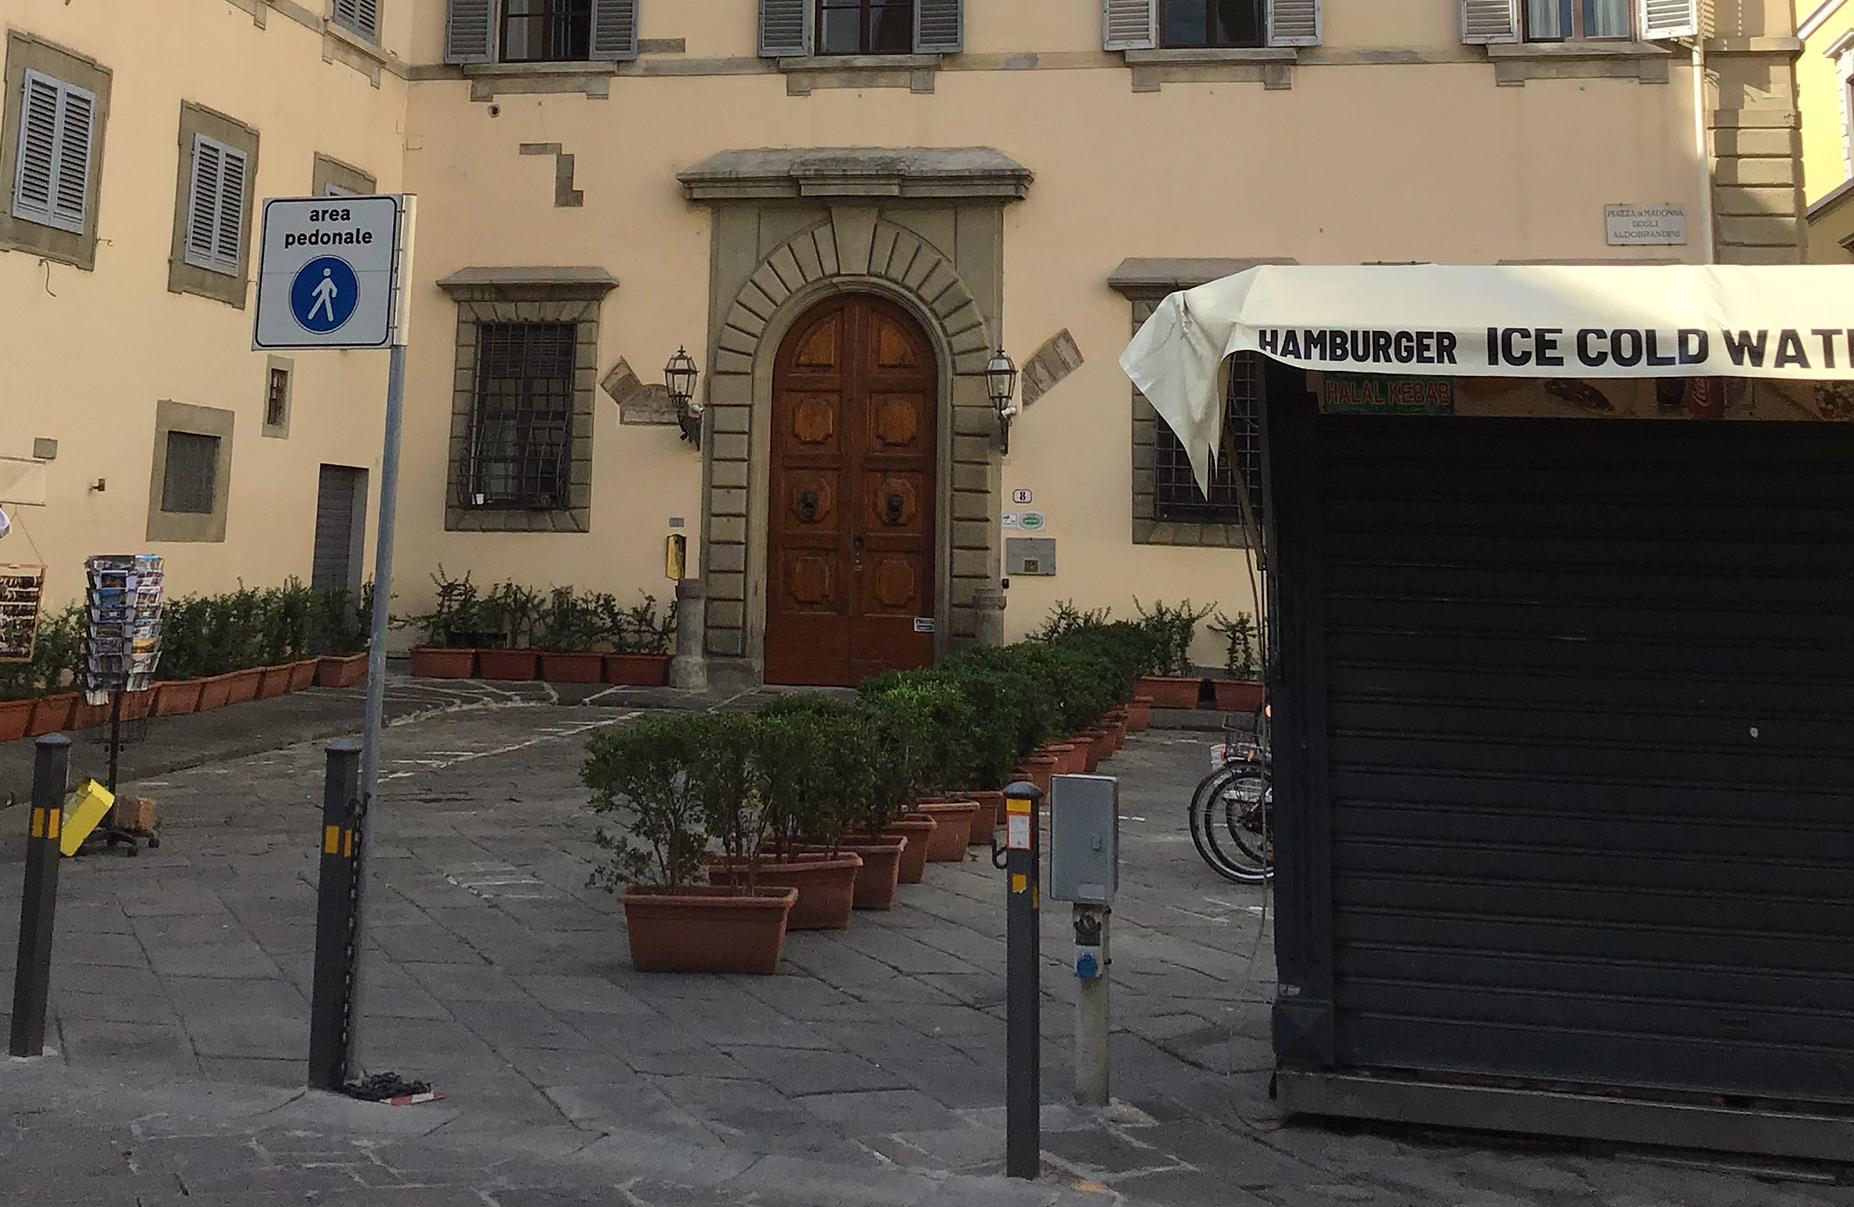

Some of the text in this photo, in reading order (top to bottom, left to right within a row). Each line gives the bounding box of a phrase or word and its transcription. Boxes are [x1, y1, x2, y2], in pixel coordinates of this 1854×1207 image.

[309, 208, 351, 222] area
[1607, 209, 1636, 218] PIAZZA
[1643, 209, 1684, 218] MADONNA
[1632, 220, 1659, 228] DEGLI
[284, 228, 373, 249] pedonale
[1258, 327, 1854, 369] HAMBURGER ICE COLD WAT
[1326, 380, 1450, 405] HALAL KEBAB
[1019, 491, 1027, 501] 8
